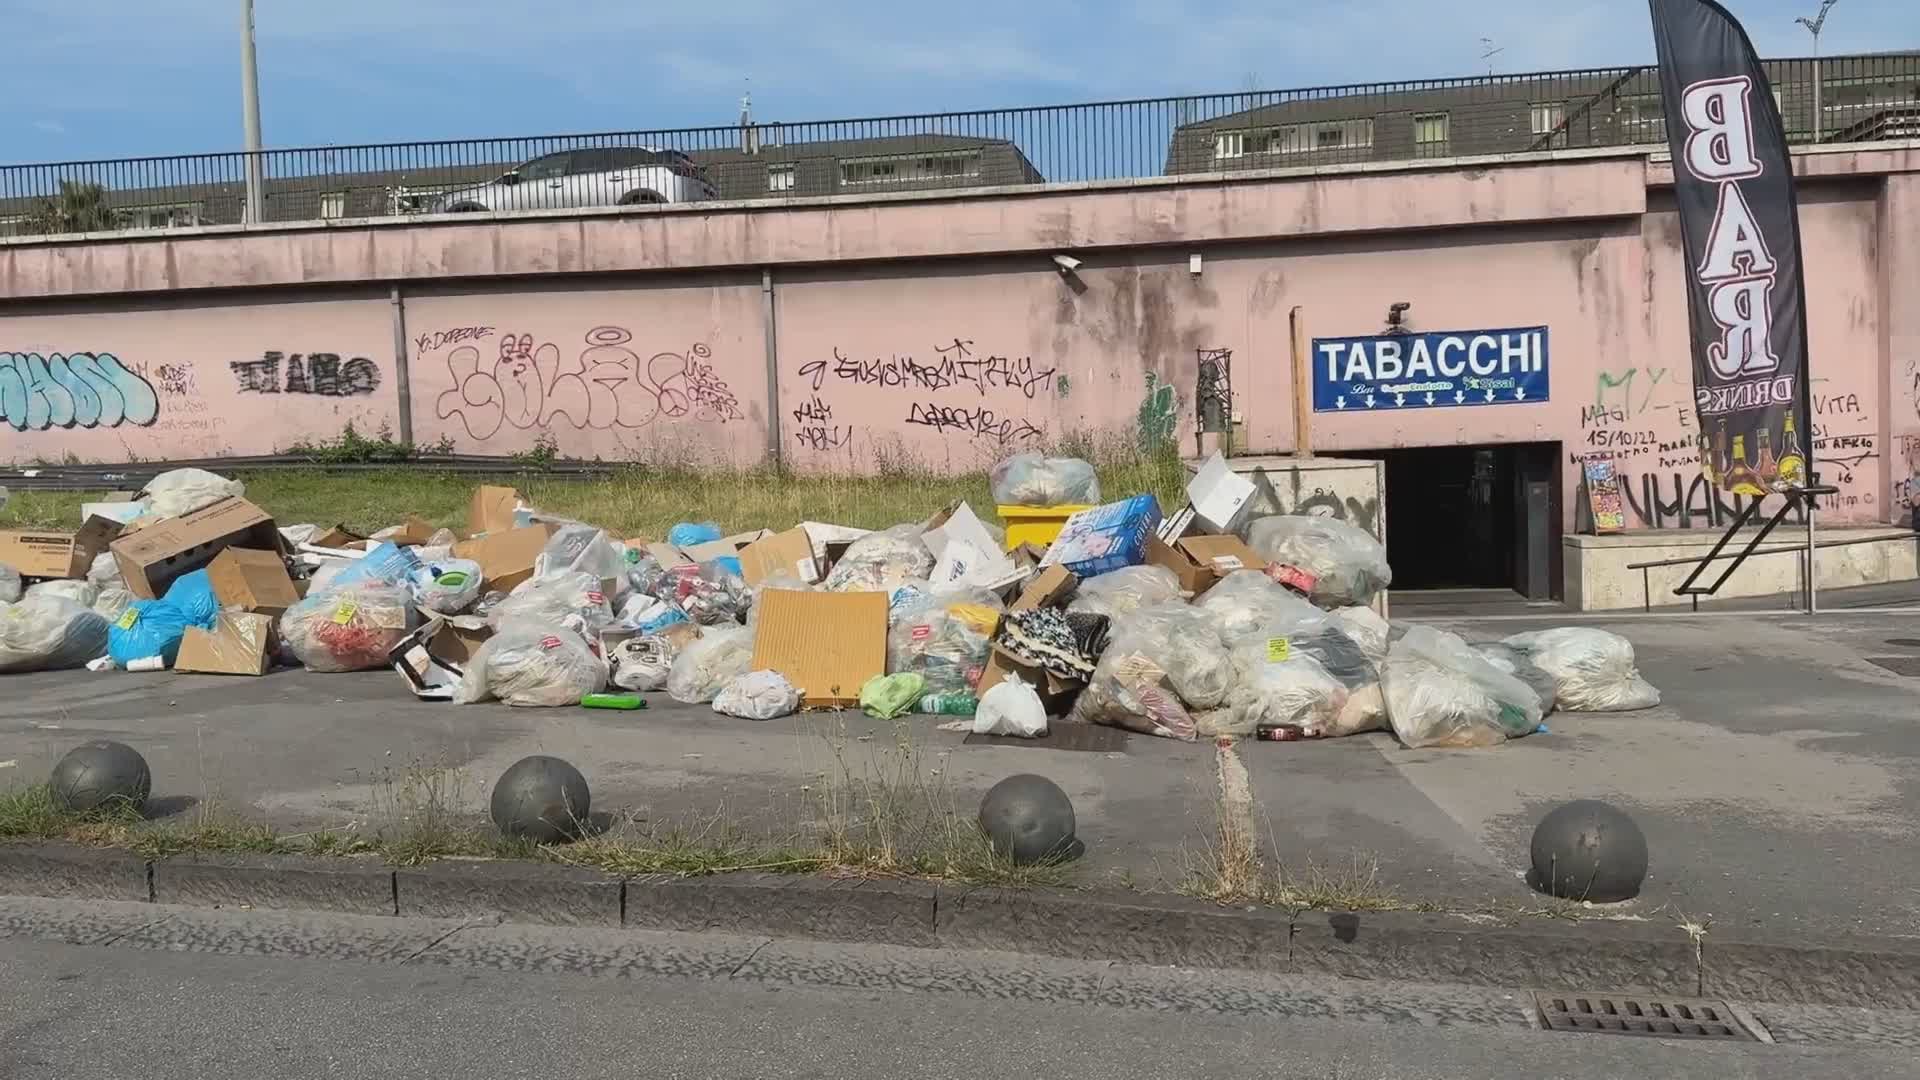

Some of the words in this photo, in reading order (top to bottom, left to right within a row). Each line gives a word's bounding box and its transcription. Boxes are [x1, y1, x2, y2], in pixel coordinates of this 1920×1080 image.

[1319, 332, 1542, 382] TABACCHI
[1813, 393, 1860, 416] VITA
[1587, 430, 1658, 447] 15/10/22
